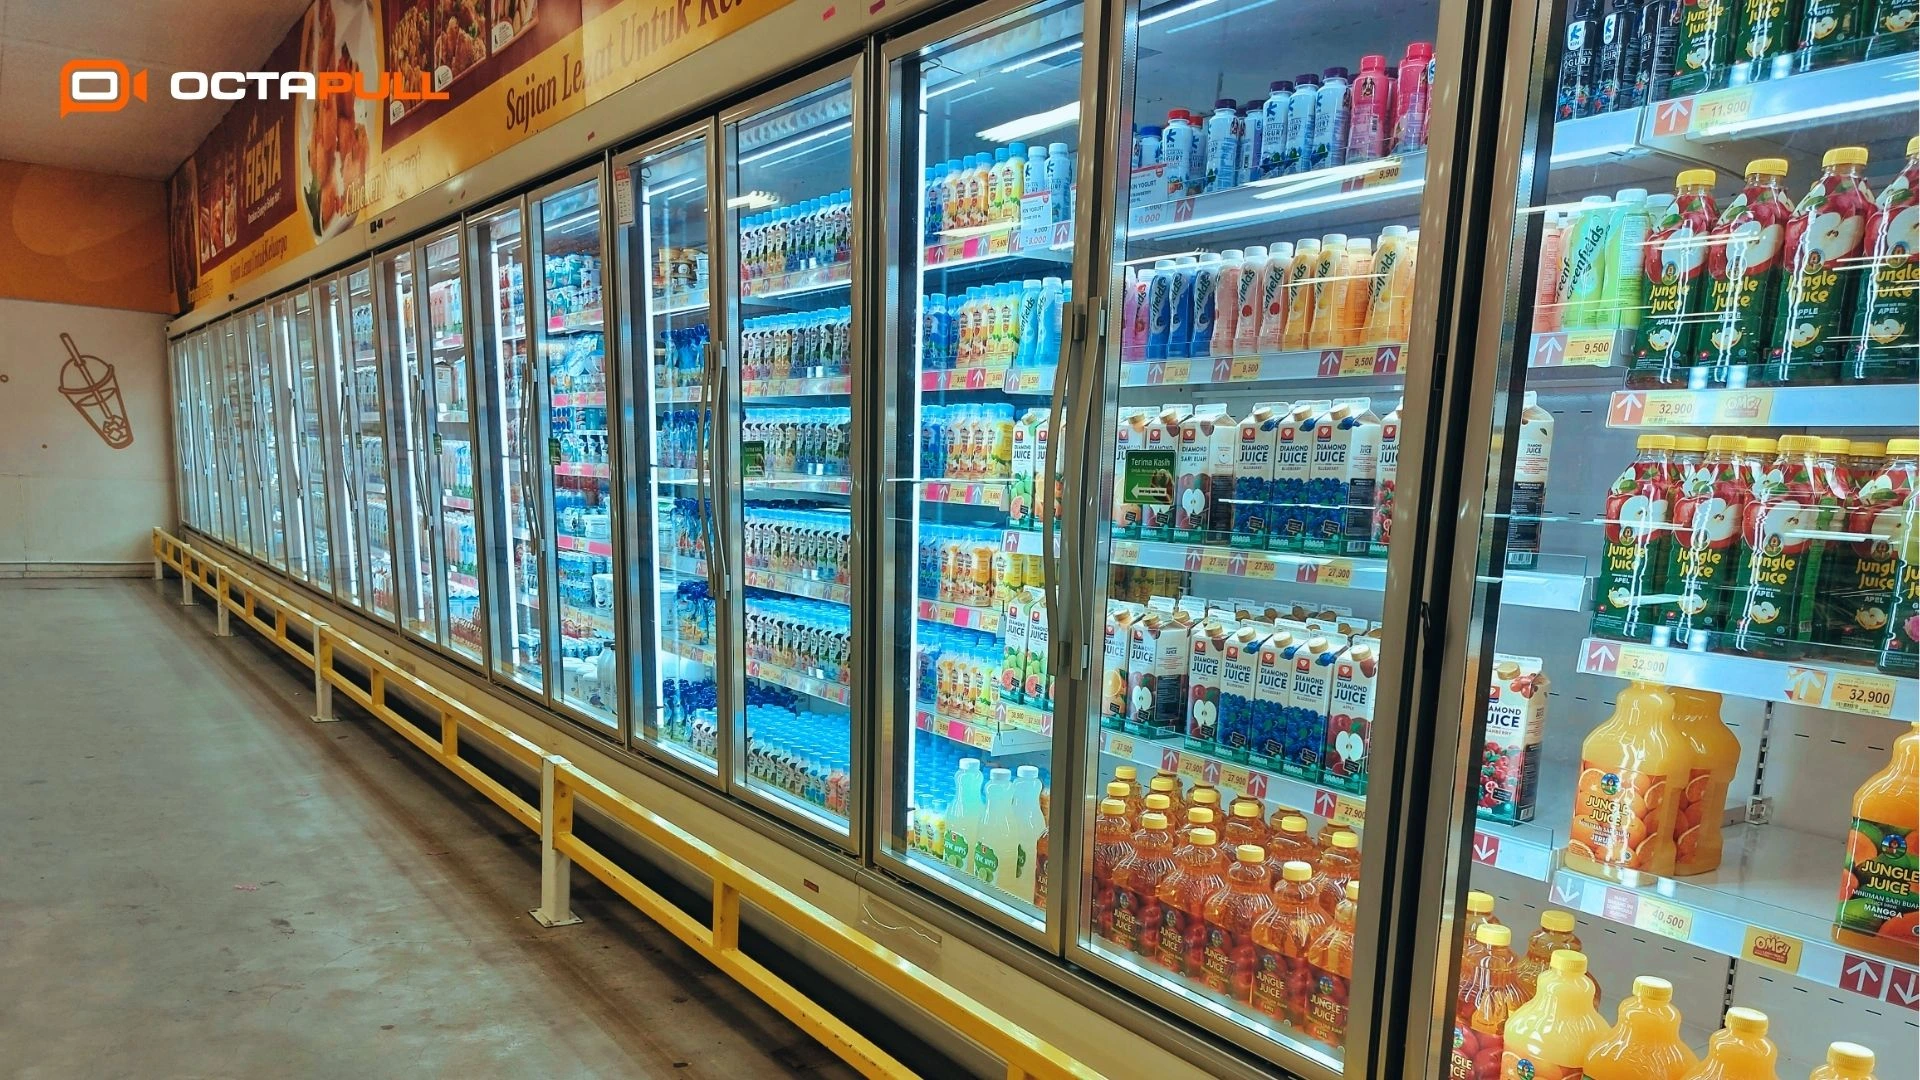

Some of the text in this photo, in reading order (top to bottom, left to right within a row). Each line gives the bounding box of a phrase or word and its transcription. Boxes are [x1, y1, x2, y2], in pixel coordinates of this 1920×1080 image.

[1686, 5, 1724, 25] Jungle
[1688, 22, 1716, 38] Juice
[506, 73, 557, 133] Sajian
[562, 33, 614, 102] Lezat
[619, 0, 691, 69] Untuk
[245, 119, 282, 209] FIESTA
[1379, 167, 1400, 180] 9,900
[1567, 223, 1604, 300] Greenfields
[1875, 263, 1920, 283] ungle
[1786, 270, 1838, 293] Jngle
[1264, 267, 1284, 313] enfields
[1649, 284, 1691, 302] Jungle
[1877, 284, 1914, 298] uice
[1650, 299, 1682, 315] Juice
[1877, 307, 1900, 316] APEL
[1584, 342, 1610, 354] 9,500
[1354, 356, 1374, 368] 9,500
[1659, 403, 1693, 415] 32,900
[1316, 443, 1347, 451] DIAMOND
[1013, 450, 1032, 460] JUICE
[1239, 452, 1269, 462] JUICE
[1277, 453, 1308, 463] JUICE
[1314, 451, 1346, 462] JUICE
[1131, 458, 1171, 467] Terima Kasih
[1608, 543, 1646, 558] Jungle
[1254, 562, 1275, 571] 27,900
[1748, 554, 1796, 572] Jngle
[1856, 558, 1897, 578] Jungl
[1328, 568, 1350, 578] 27,900
[1859, 574, 1896, 590] Juice
[1864, 596, 1884, 604] APEL
[1007, 625, 1025, 637] JUICE
[1029, 629, 1048, 641] JUICE
[1131, 650, 1153, 663] JUICE
[1193, 656, 1219, 665] DIAMOND
[1191, 662, 1218, 676] JUICE
[1225, 661, 1251, 672] DIAMOND
[1260, 667, 1289, 678] DIAMOND
[1632, 659, 1665, 673] 32,900
[1223, 668, 1250, 683] JUICE
[1258, 674, 1288, 690] JUICE
[1295, 674, 1324, 686] DIAMOND
[1293, 681, 1323, 697] JUICE
[1336, 681, 1368, 693] DIAMOND
[1334, 688, 1367, 705] JUICE
[1849, 688, 1891, 706] 32,900
[1488, 706, 1522, 717] AMOND
[1486, 713, 1521, 729] UICE
[1485, 727, 1512, 737] RANBERRY
[1228, 773, 1247, 785] 27,900
[1345, 805, 1367, 818] 27,900
[1590, 833, 1613, 846] JERU
[1861, 860, 1920, 883] JUNGLE
[1866, 876, 1910, 896] JUICE
[1851, 888, 1885, 903] MINUMAN
[1885, 896, 1902, 906] SARI
[1863, 903, 1904, 919] MANGGA
[1873, 912, 1892, 921] MANGO
[1652, 908, 1685, 929] 40,500
[1115, 920, 1132, 933] JUICE
[1161, 938, 1179, 953] JUICE
[1755, 935, 1792, 957] OMG!
[1206, 960, 1225, 974] JUICE
[1256, 970, 1285, 990] JUNGLE
[1260, 983, 1281, 998] JUICE
[1310, 993, 1341, 1014] JUNGLE
[1313, 1006, 1336, 1023] JUICE
